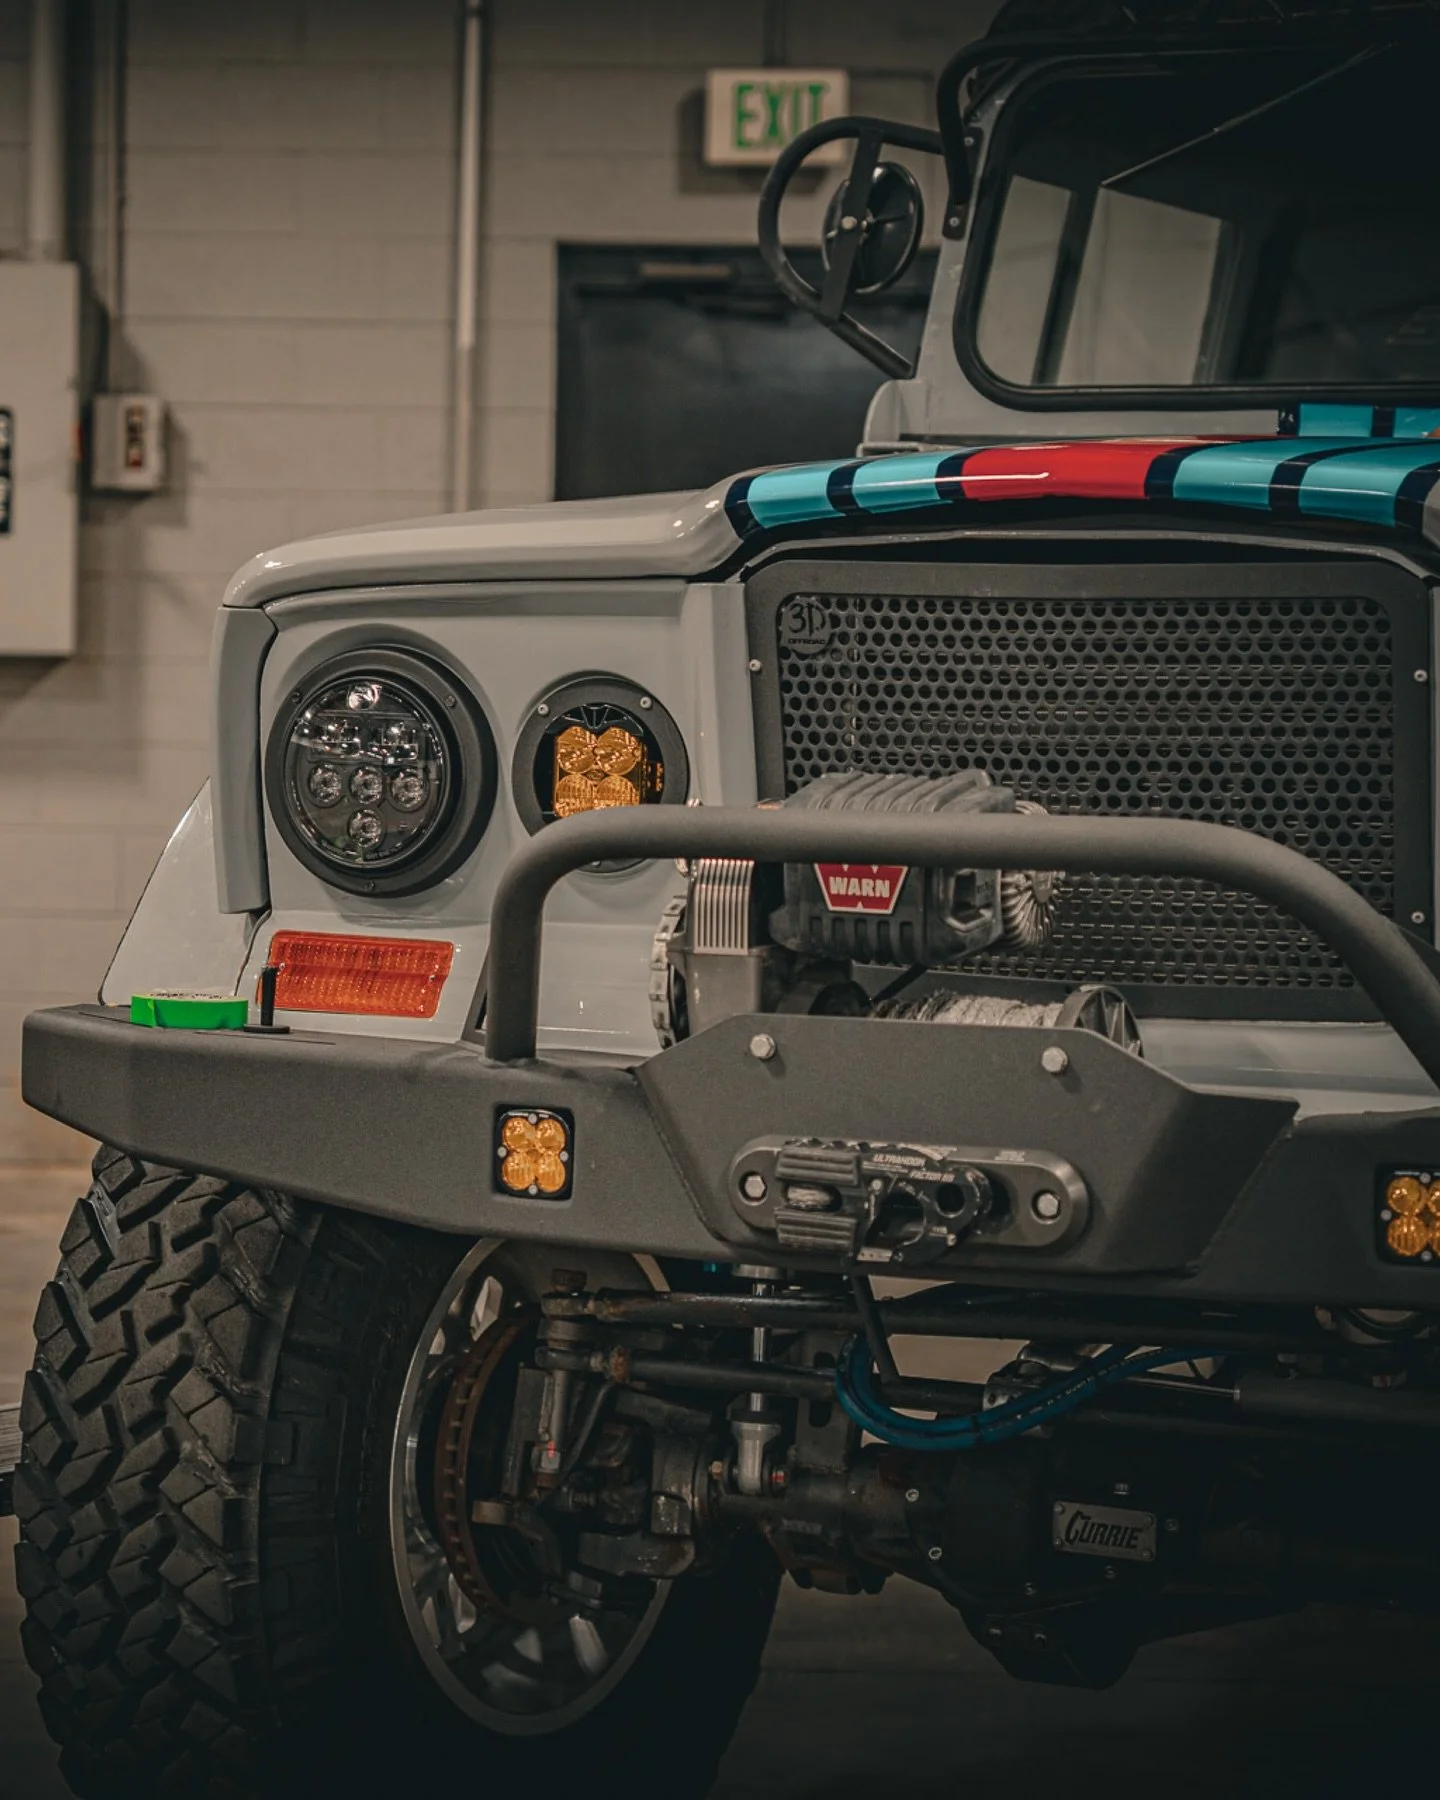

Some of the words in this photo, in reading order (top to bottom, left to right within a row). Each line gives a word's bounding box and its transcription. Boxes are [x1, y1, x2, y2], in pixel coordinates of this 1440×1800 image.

[733, 81, 828, 148] EXIT
[829, 876, 890, 898] WARN
[910, 1170, 940, 1181] FACTOR
[1065, 1510, 1143, 1549] CURRIE
